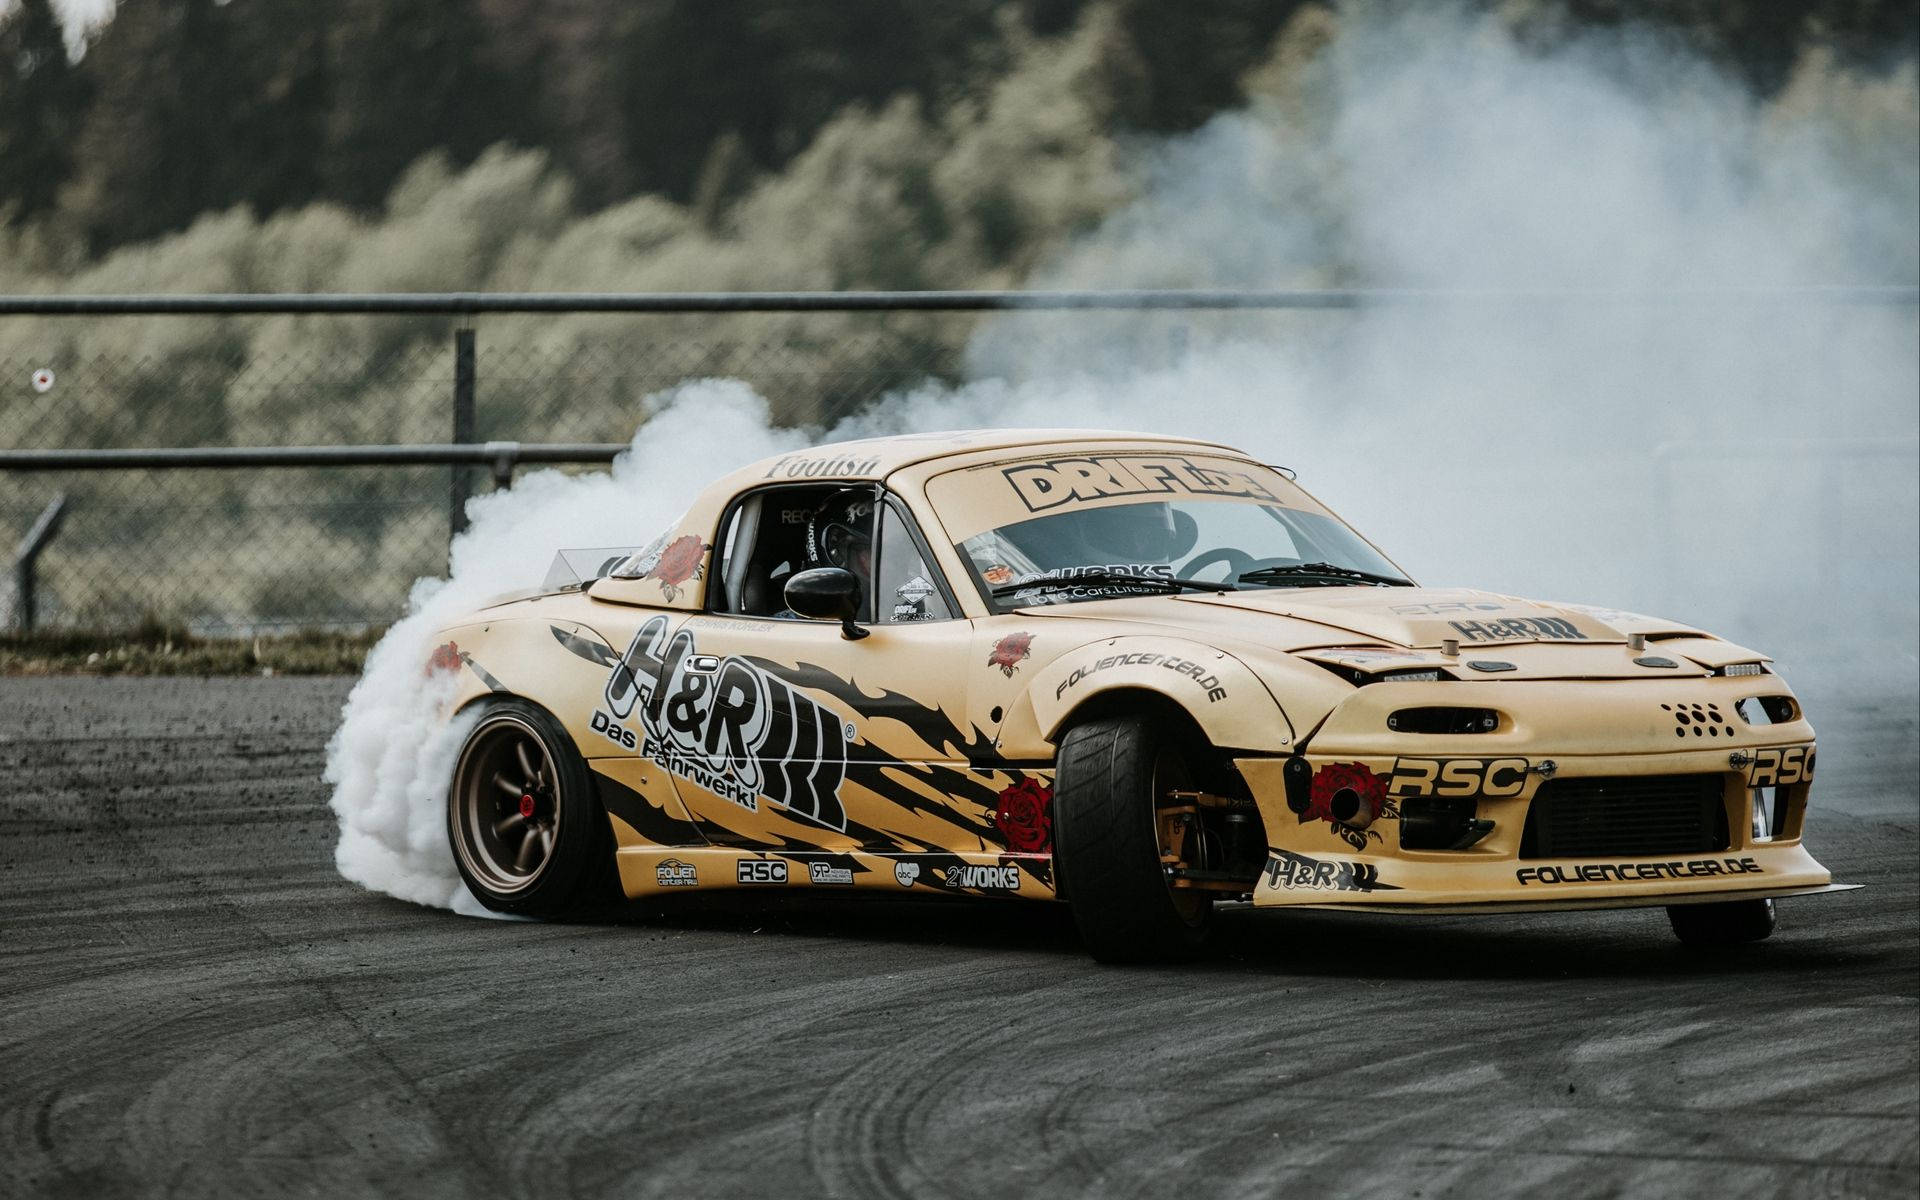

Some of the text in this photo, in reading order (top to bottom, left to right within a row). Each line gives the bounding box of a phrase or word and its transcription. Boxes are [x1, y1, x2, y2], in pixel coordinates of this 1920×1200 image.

[762, 454, 883, 479] Foolish
[1448, 617, 1541, 642] H&R
[605, 615, 767, 789] H&R
[591, 710, 757, 811] Das Fahrwerk!
[1389, 759, 1527, 796] RSC
[739, 863, 786, 881] RSC
[1268, 860, 1340, 890] H&R
[1516, 858, 1764, 885] FOLIENCENTER.DE
